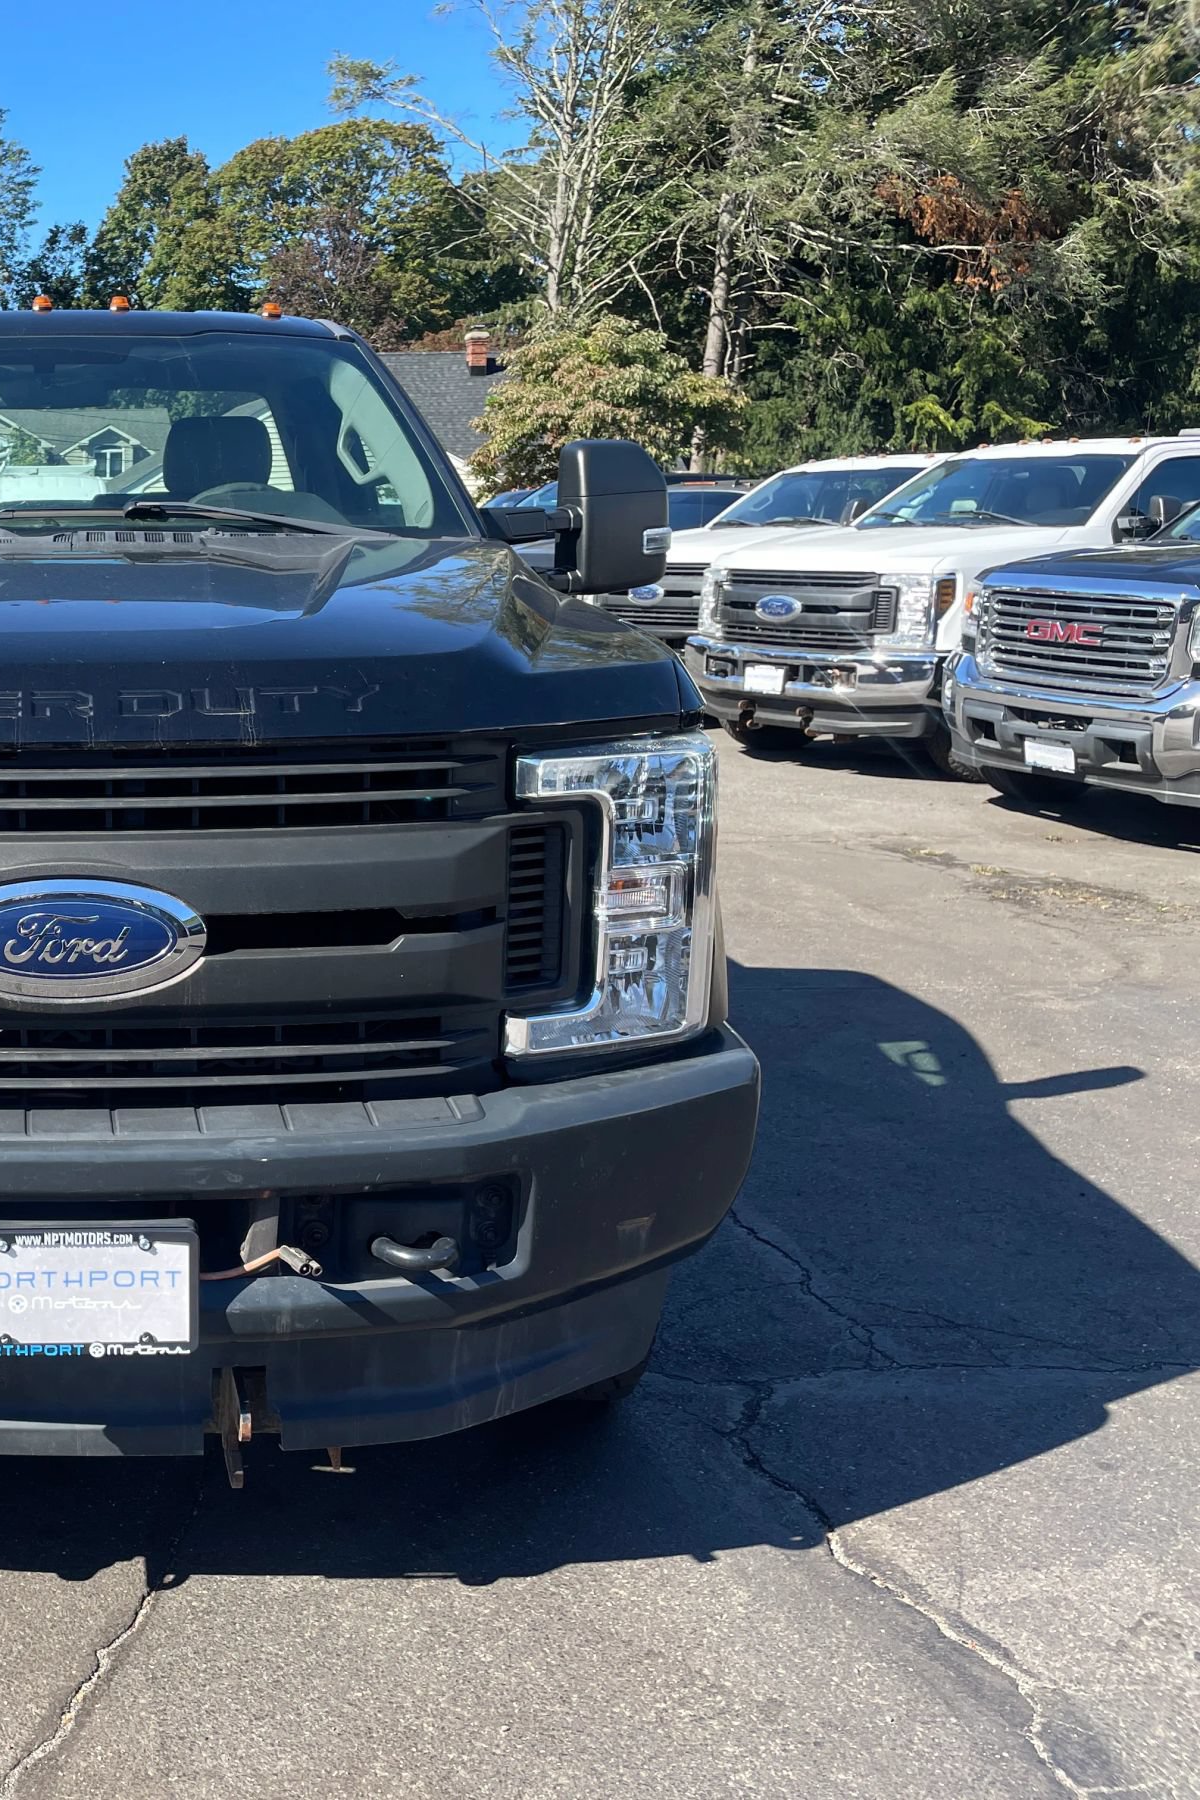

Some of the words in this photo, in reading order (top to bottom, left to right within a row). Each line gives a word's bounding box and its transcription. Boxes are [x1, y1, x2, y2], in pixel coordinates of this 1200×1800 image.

[1025, 619, 1103, 646] GMC
[118, 684, 380, 717] DUTY
[3, 912, 132, 964] Ford
[31, 1295, 142, 1310] Motors
[106, 1343, 191, 1356] Motors
